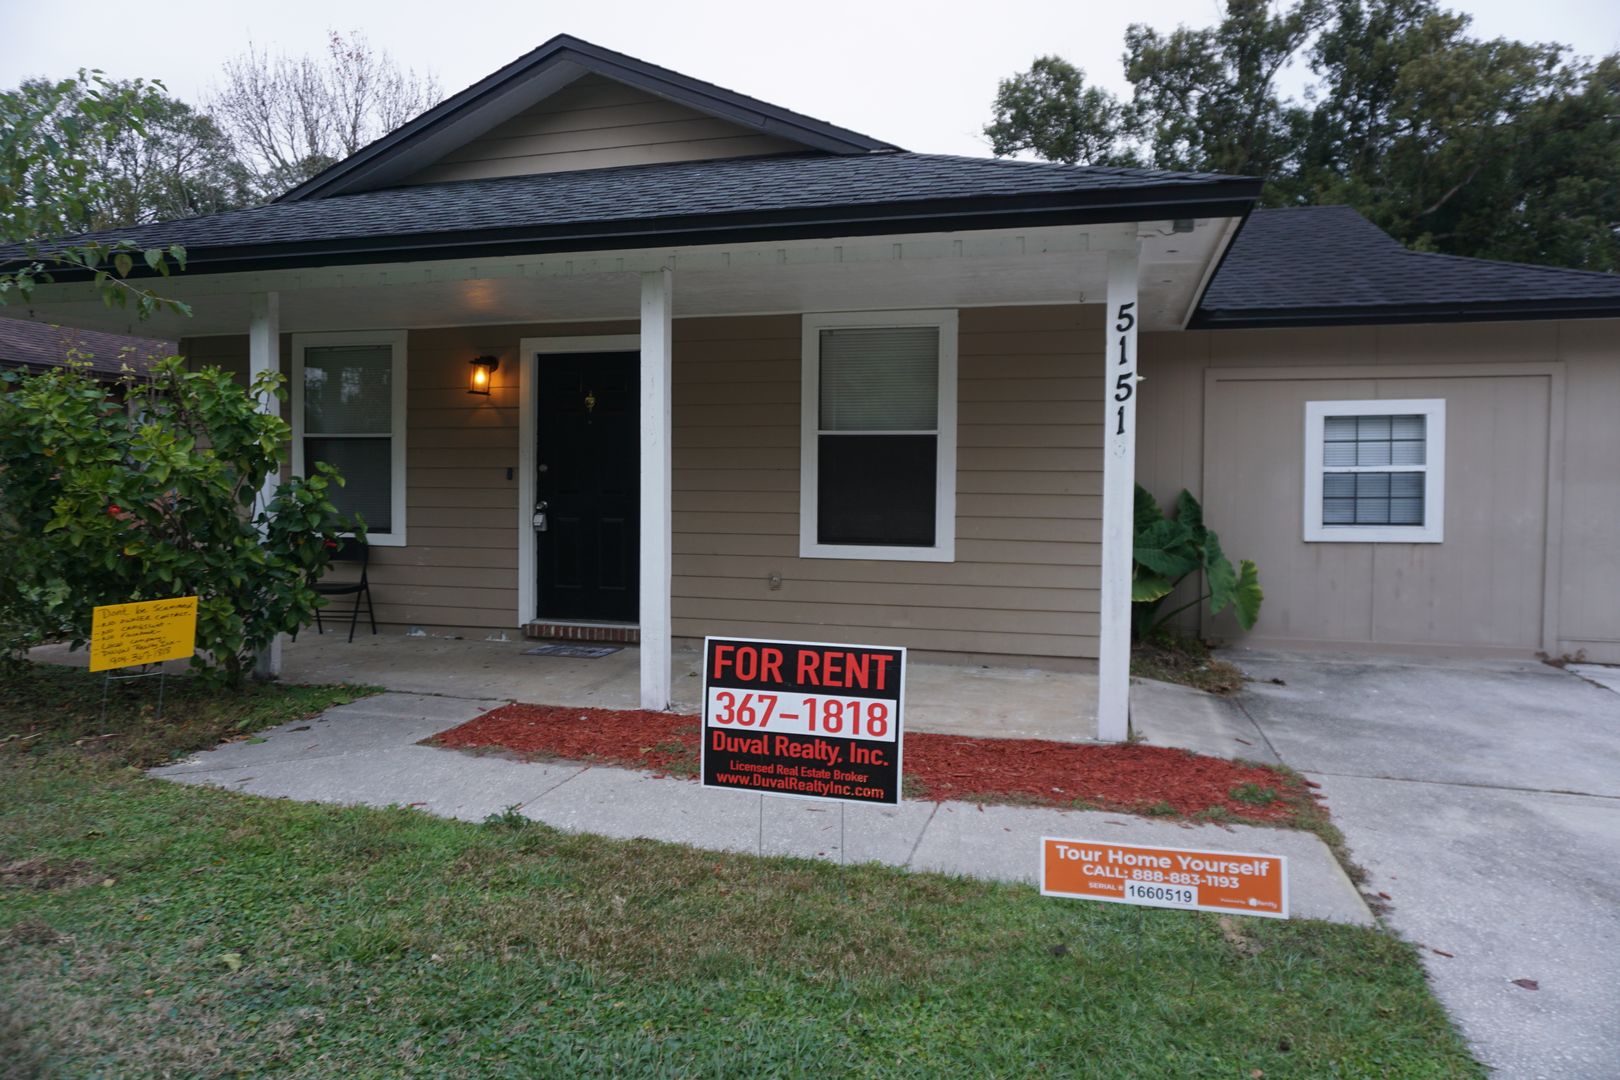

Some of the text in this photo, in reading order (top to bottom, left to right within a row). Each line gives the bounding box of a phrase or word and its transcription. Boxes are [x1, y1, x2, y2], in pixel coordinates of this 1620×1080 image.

[1115, 302, 1135, 435] 5151
[136, 606, 146, 614] be
[714, 645, 894, 690] FOR RENT
[715, 692, 888, 737] 367-1818
[712, 730, 770, 755] Duval
[850, 743, 889, 766] Inc.
[730, 760, 868, 783] Licensed Real Estate Broker
[717, 772, 884, 798] www.DuvalRealtyInc.com
[1056, 844, 1270, 877] Tour Home Yourself
[1082, 863, 1240, 889] CALL: 888-883-1193
[1088, 882, 1117, 890] SERIAL
[1129, 885, 1192, 903] 1660519
